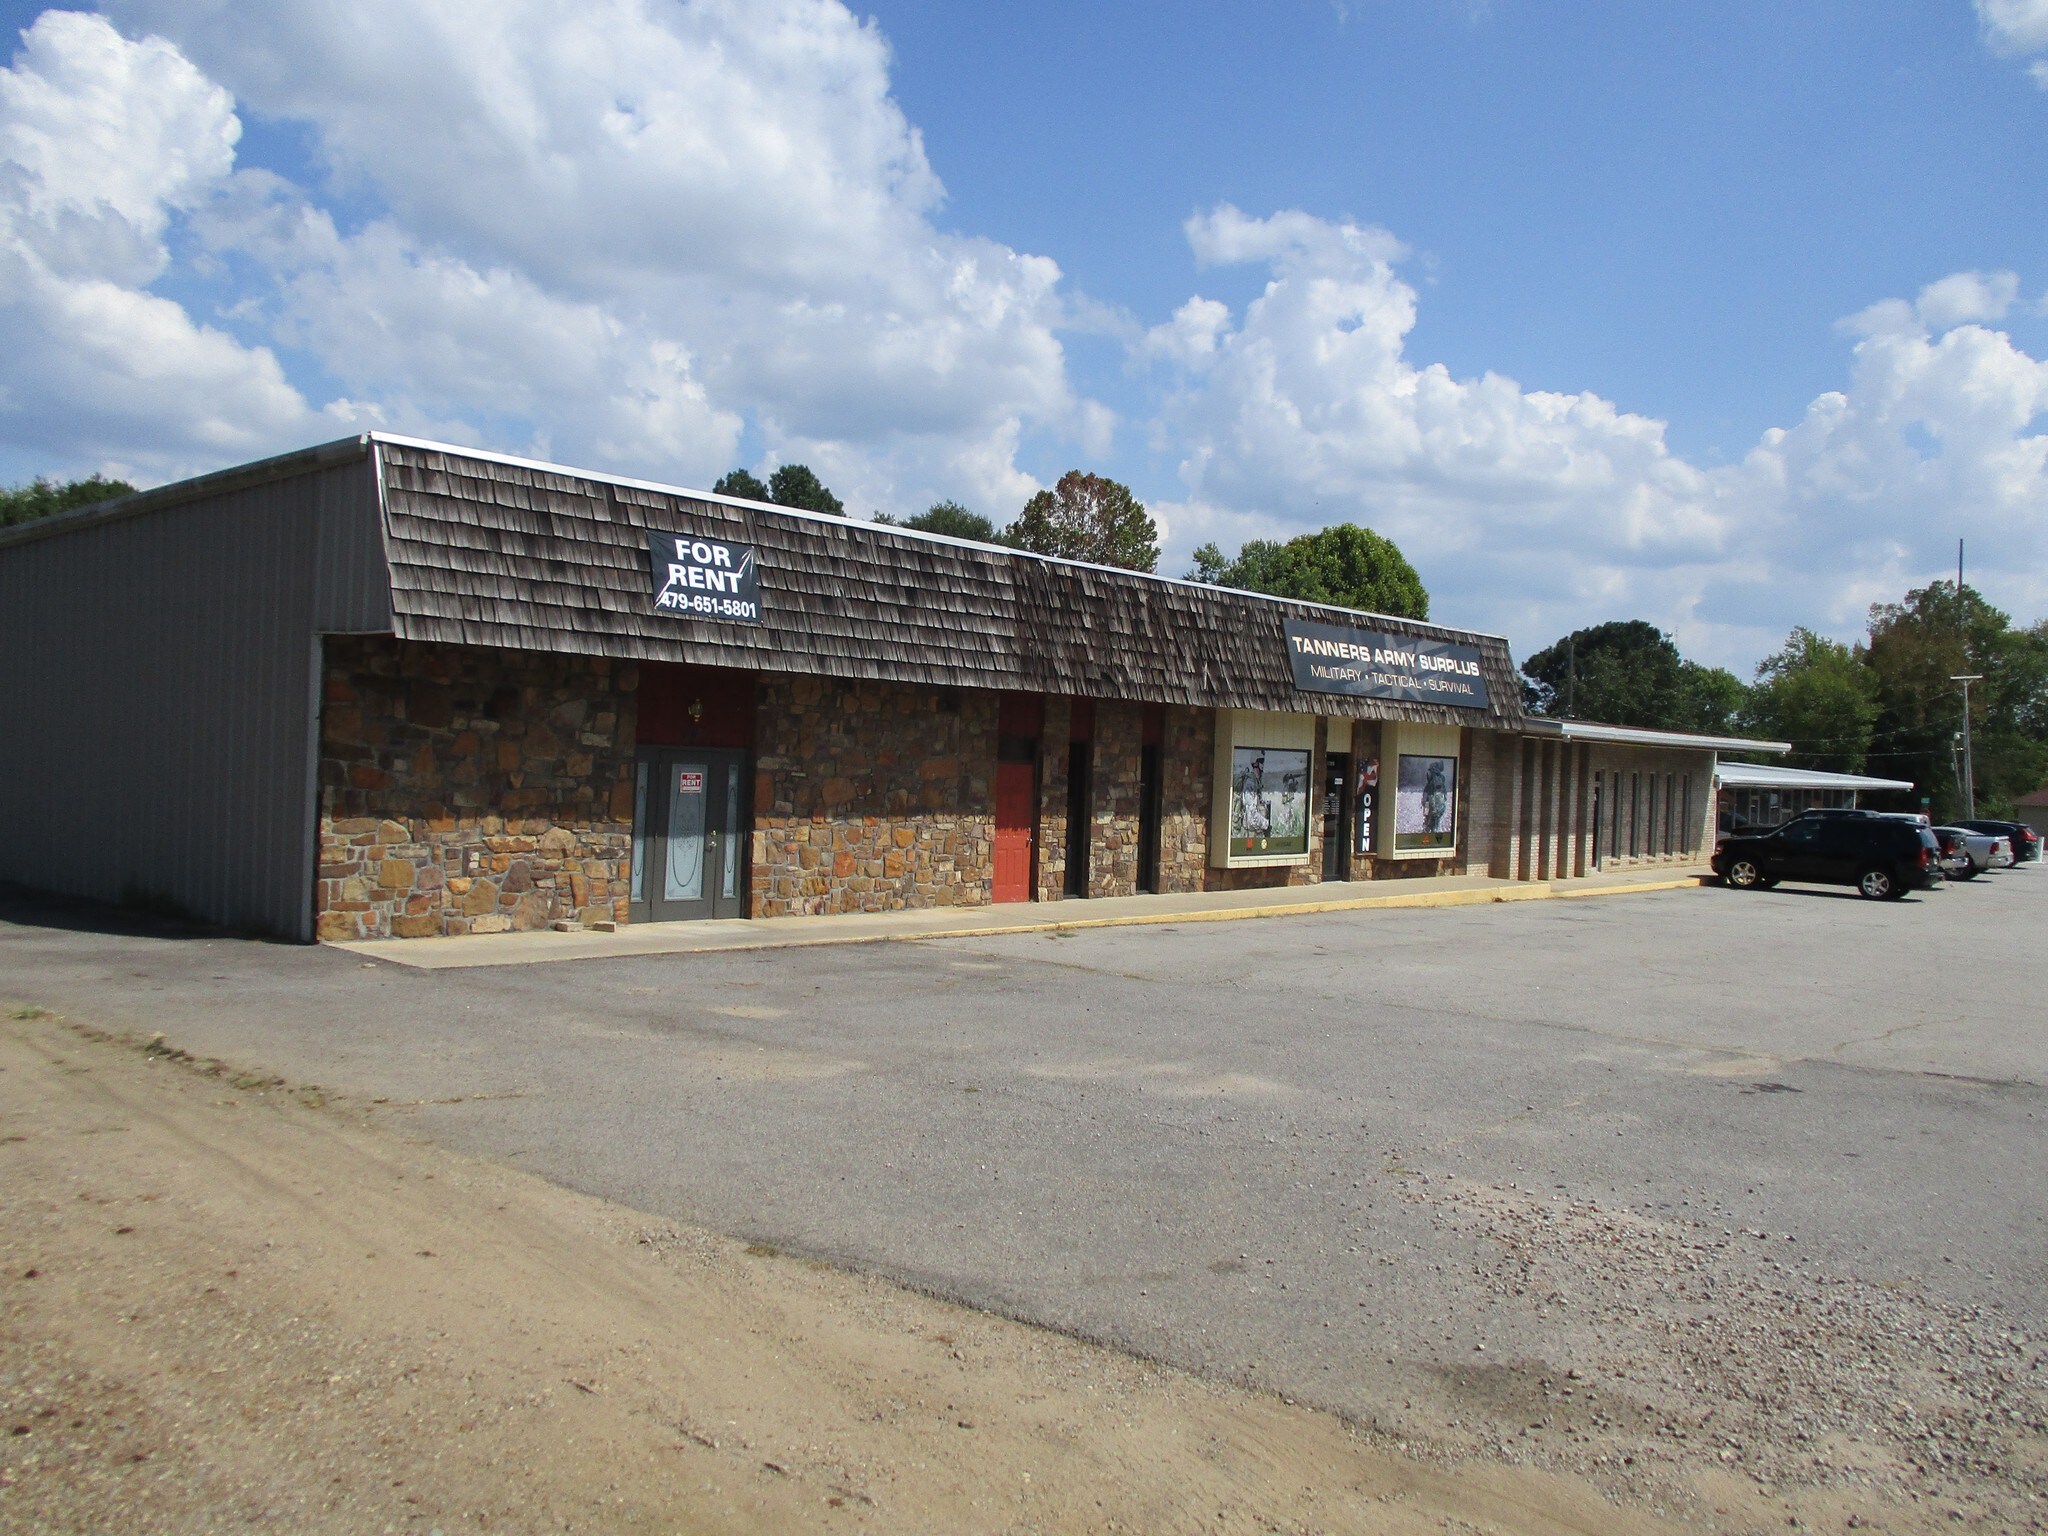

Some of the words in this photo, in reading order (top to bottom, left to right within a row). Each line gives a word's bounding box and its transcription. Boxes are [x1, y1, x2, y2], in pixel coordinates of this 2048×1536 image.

[675, 539, 731, 568] FOR
[668, 563, 743, 593] RENT
[661, 591, 756, 618] 479-651-5801
[1292, 636, 1371, 662] TANNERS
[1374, 648, 1416, 667] ARMY
[1419, 654, 1480, 677] SURPLUS
[1311, 665, 1362, 682] MILITARY
[1372, 672, 1421, 689] TACTICAL
[1429, 679, 1474, 695] SURVIVAL
[1362, 793, 1372, 852] OPEN
